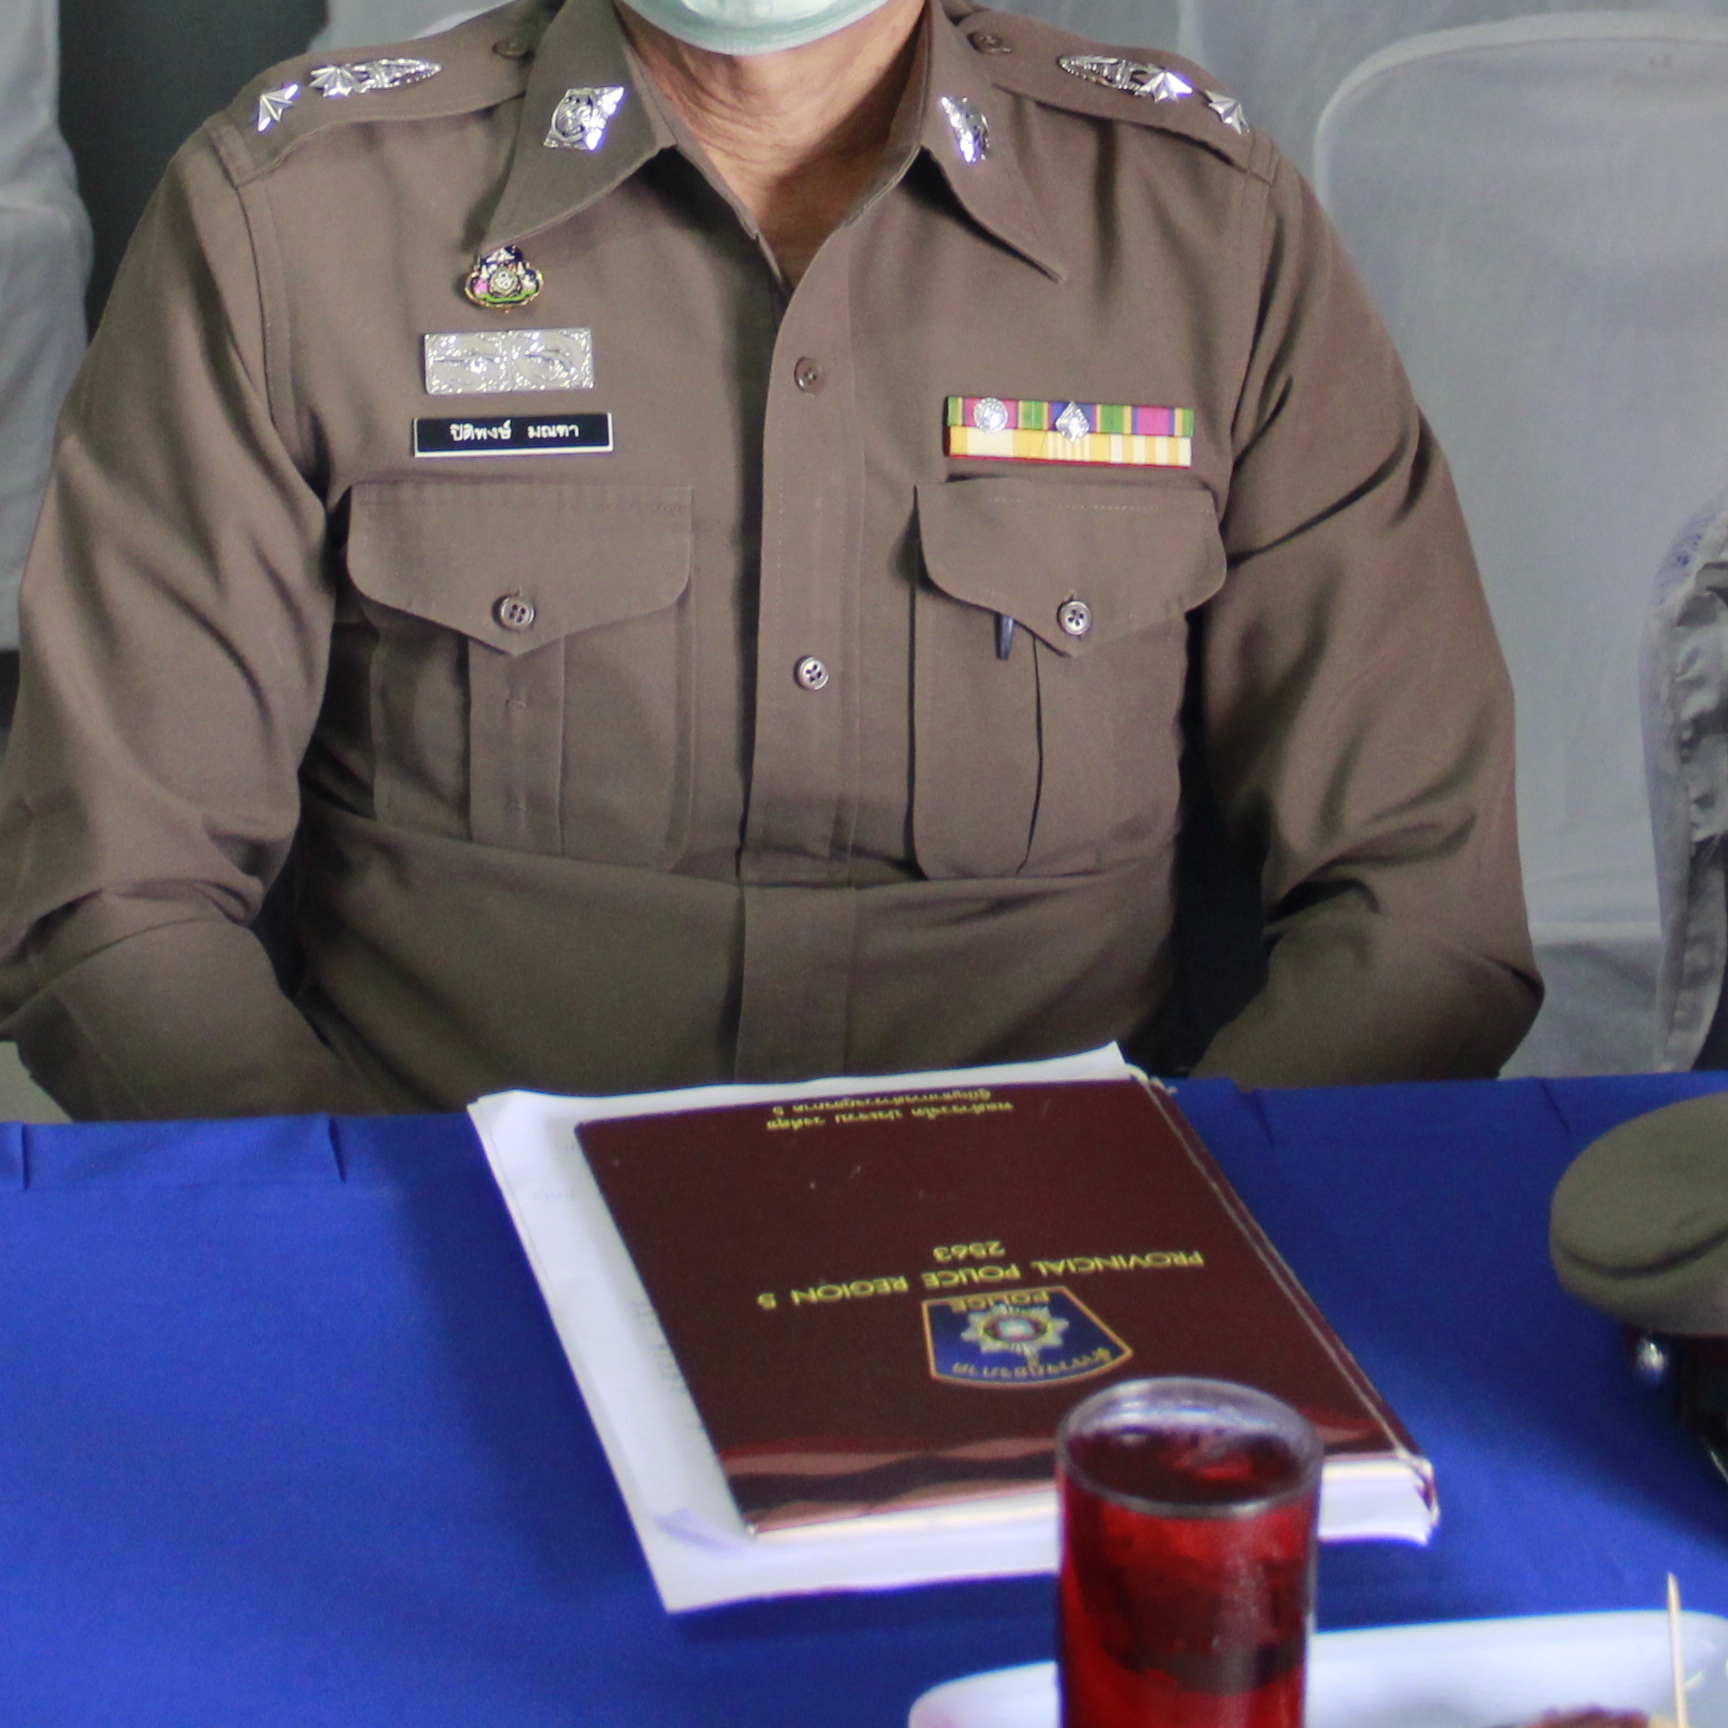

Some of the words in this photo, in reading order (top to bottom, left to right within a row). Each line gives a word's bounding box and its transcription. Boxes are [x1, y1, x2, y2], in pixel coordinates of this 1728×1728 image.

[932, 1240, 1006, 1263] 2563
[1032, 1250, 1205, 1278] PROVINCIAL
[922, 1262, 1022, 1289] POLICE
[791, 1275, 909, 1306] REGION
